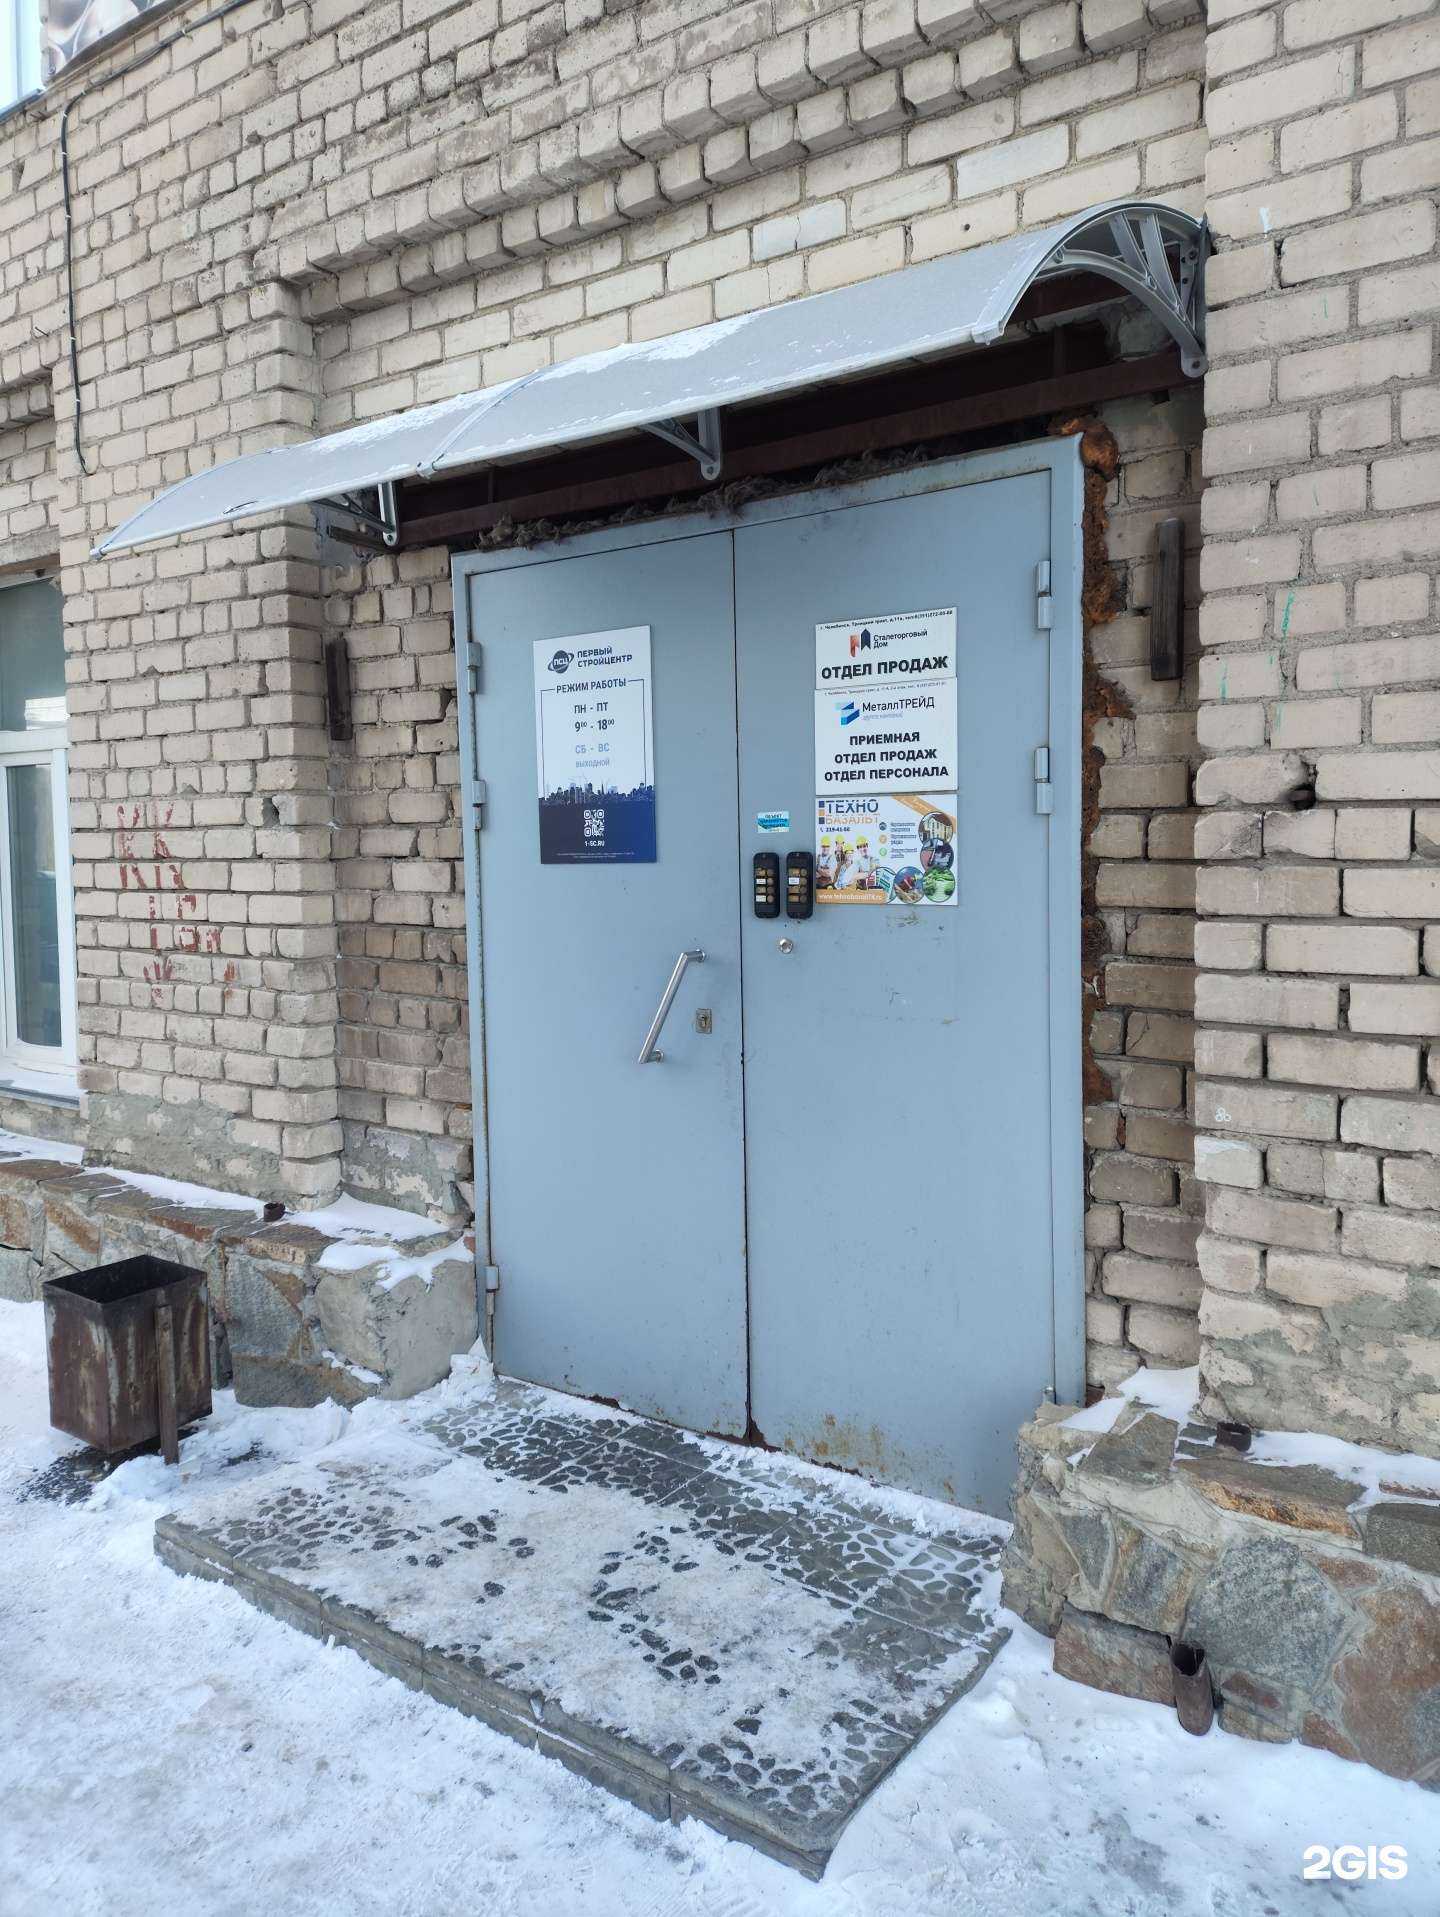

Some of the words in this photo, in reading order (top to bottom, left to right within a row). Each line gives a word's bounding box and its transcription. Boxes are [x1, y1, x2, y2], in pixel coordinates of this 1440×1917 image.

[873, 629, 928, 642] Сталеторговый
[577, 646, 613, 658] ПЕРВЫЙ
[873, 641, 889, 649] Дом
[577, 654, 633, 668] СТРОЙЦЕНТР
[821, 663, 872, 680] ОТДЕЛ
[877, 655, 949, 675] ПРОДАЖ
[556, 681, 589, 694] РЕЖИМ
[590, 678, 627, 690] РАБОТЫ
[574, 704, 587, 714] ПН
[596, 701, 609, 712] ПТ
[862, 696, 935, 713] МеталлТРЕЙД
[849, 731, 921, 746] ПРИЕМНАЯ
[575, 744, 587, 754] СБ
[598, 742, 610, 752] ВС
[834, 752, 876, 765] ОТДЕЛ
[880, 748, 938, 763] ПРОДАЖ
[824, 769, 866, 783] ОТДЕЛ
[869, 766, 949, 780] ПЕРСОНАЛА
[825, 798, 879, 814] ТЕХНО
